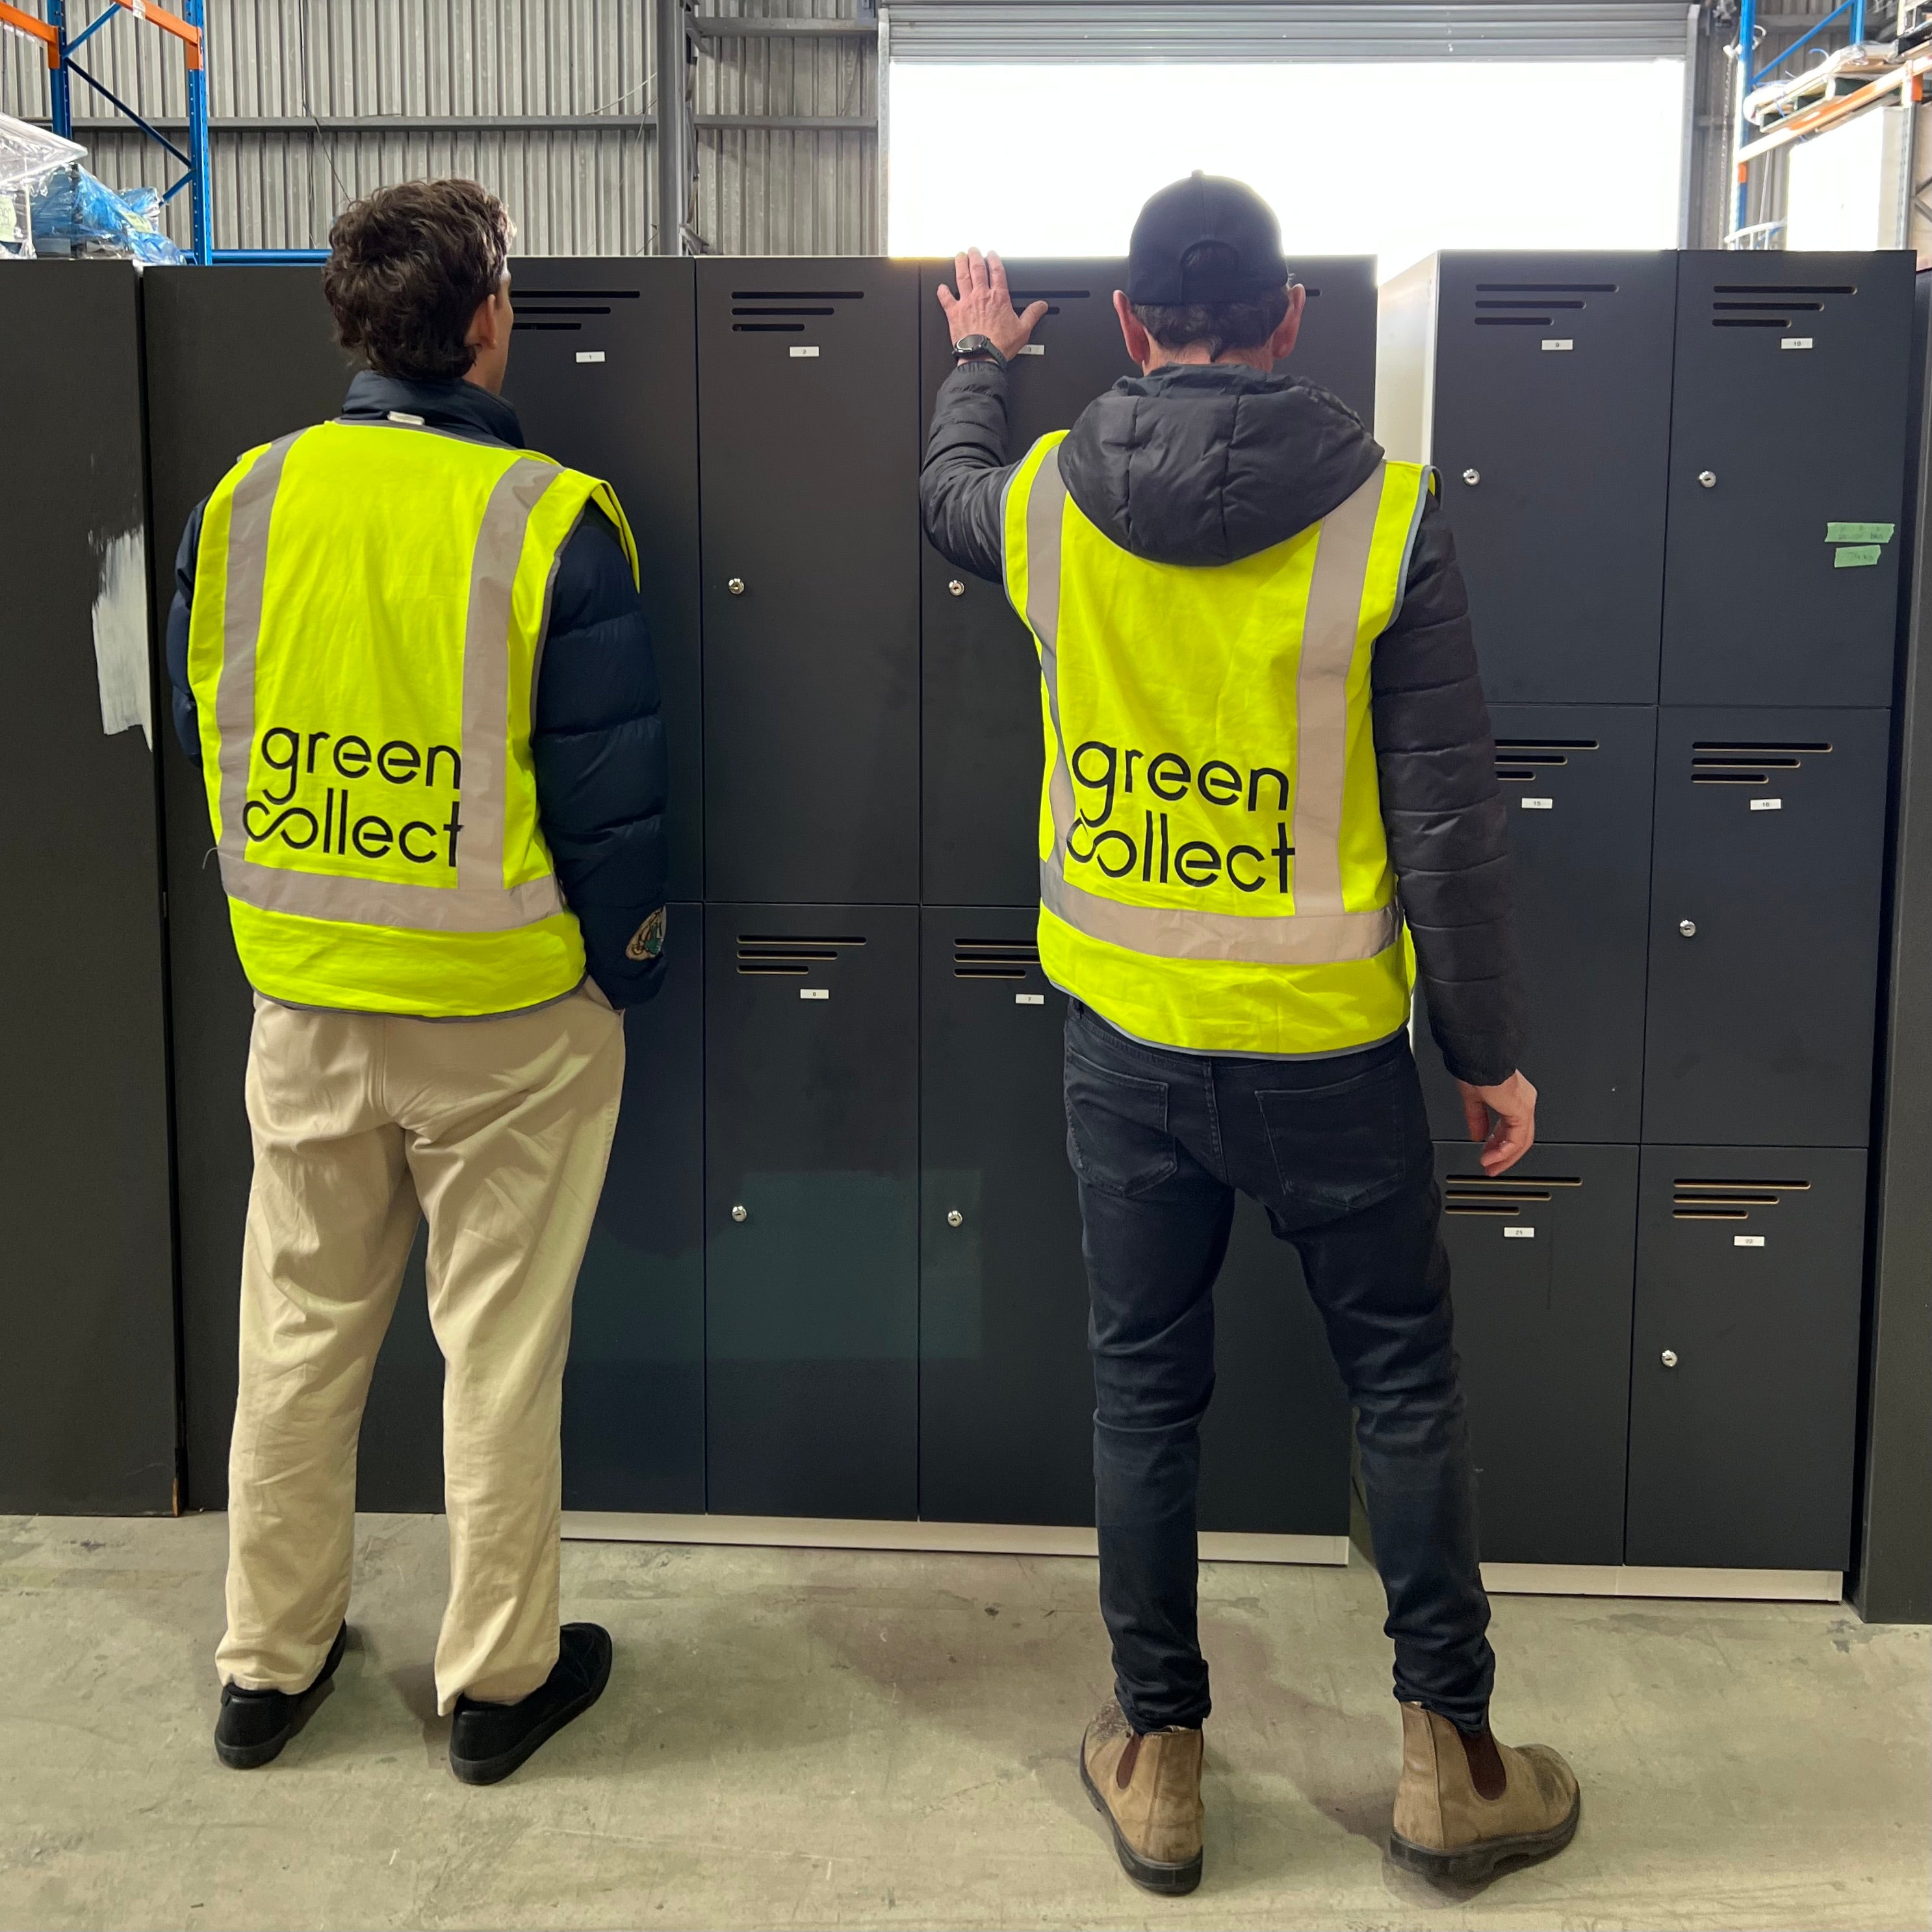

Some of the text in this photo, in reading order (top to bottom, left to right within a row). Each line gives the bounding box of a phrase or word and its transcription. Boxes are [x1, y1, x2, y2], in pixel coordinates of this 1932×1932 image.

[261, 727, 461, 805] green
[1072, 740, 1289, 828] green
[242, 788, 464, 868] collect
[1066, 810, 1296, 894] collect
